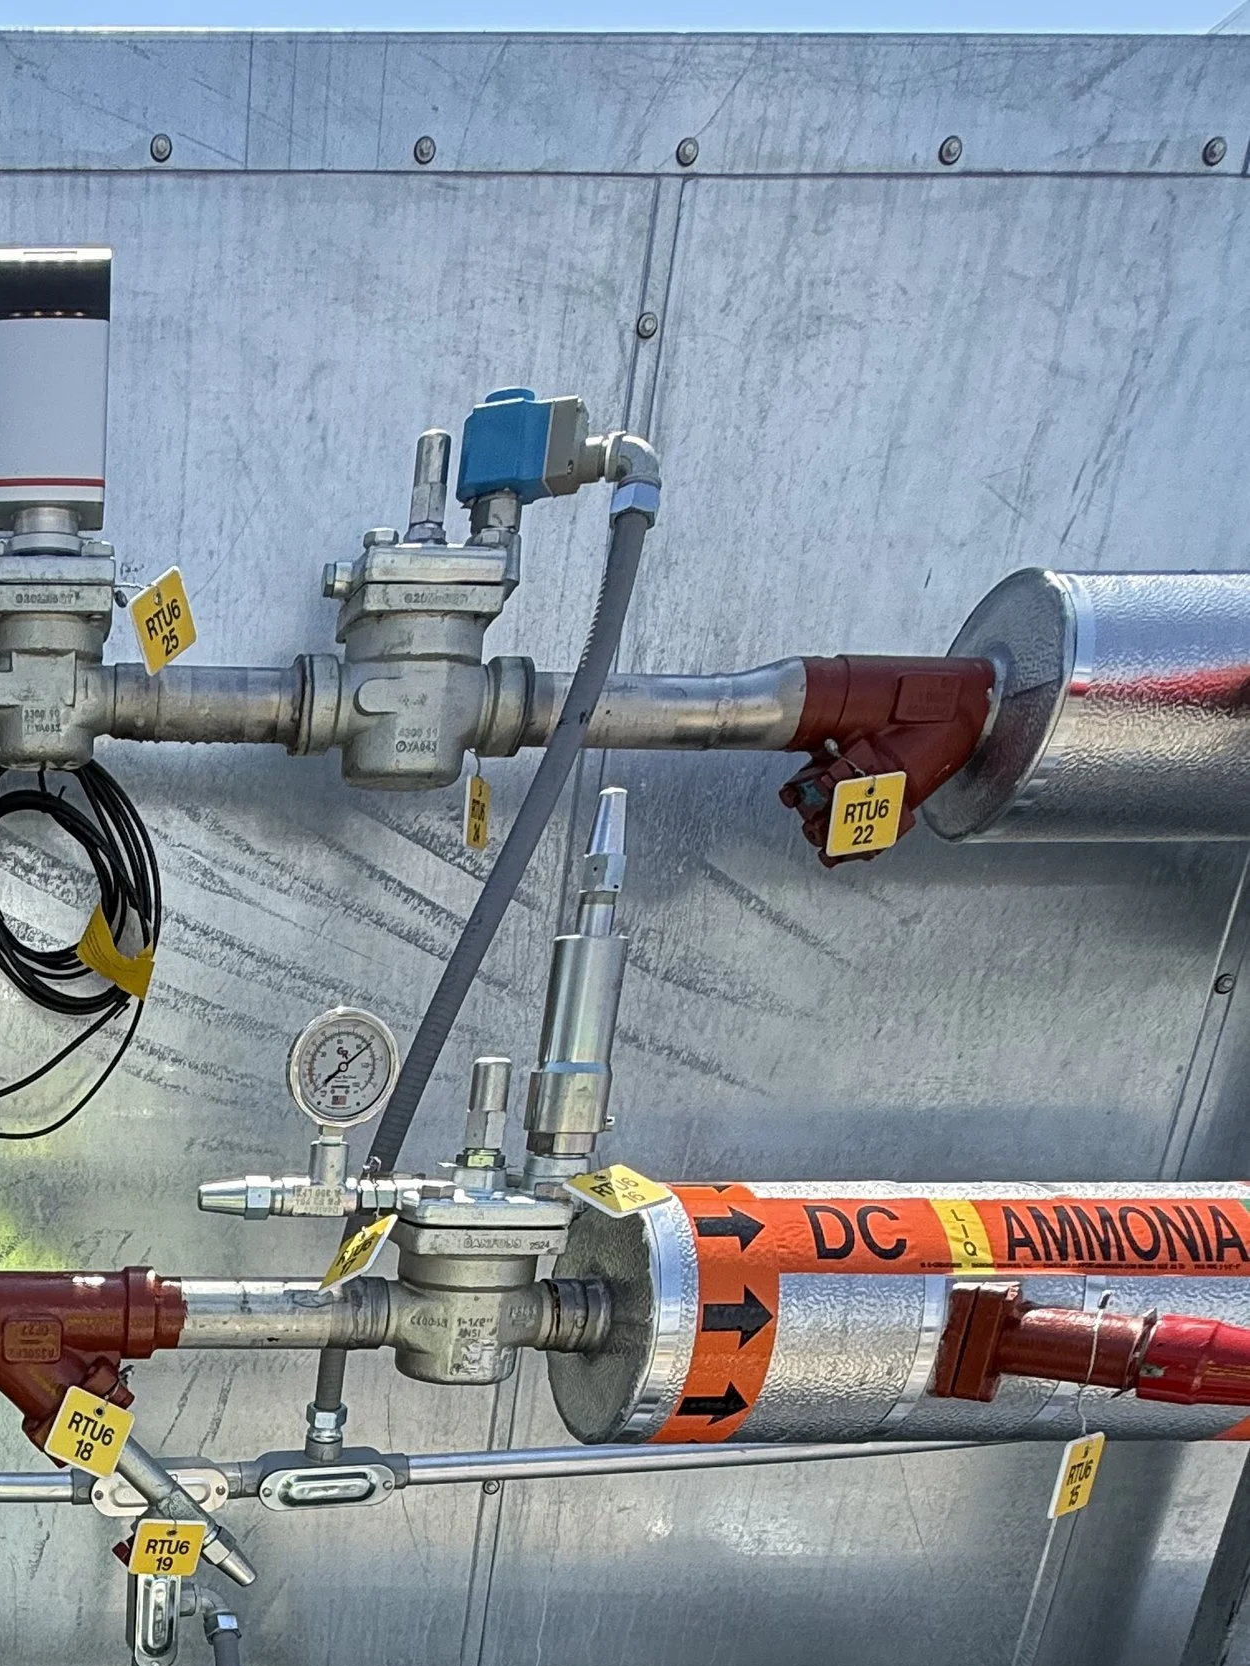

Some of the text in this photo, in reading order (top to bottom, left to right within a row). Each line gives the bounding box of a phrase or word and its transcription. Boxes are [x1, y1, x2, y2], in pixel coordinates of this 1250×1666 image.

[145, 598, 181, 641] RTU6
[162, 627, 179, 657] 25
[844, 798, 890, 824] RTU6
[851, 825, 875, 846] 22
[590, 1177, 639, 1198] RTU6
[621, 1190, 646, 1203] 16
[803, 1205, 1250, 1262] DC AMMONIA
[950, 1208, 978, 1257] LIQ
[335, 1235, 375, 1267] RTU6
[339, 1257, 356, 1278] 17
[67, 1410, 115, 1447] RTU6
[74, 1439, 94, 1462] 18
[1066, 1458, 1094, 1487] RTU6
[1068, 1484, 1081, 1507] 15
[145, 1539, 191, 1556] RTU6
[155, 1556, 174, 1572] 19
